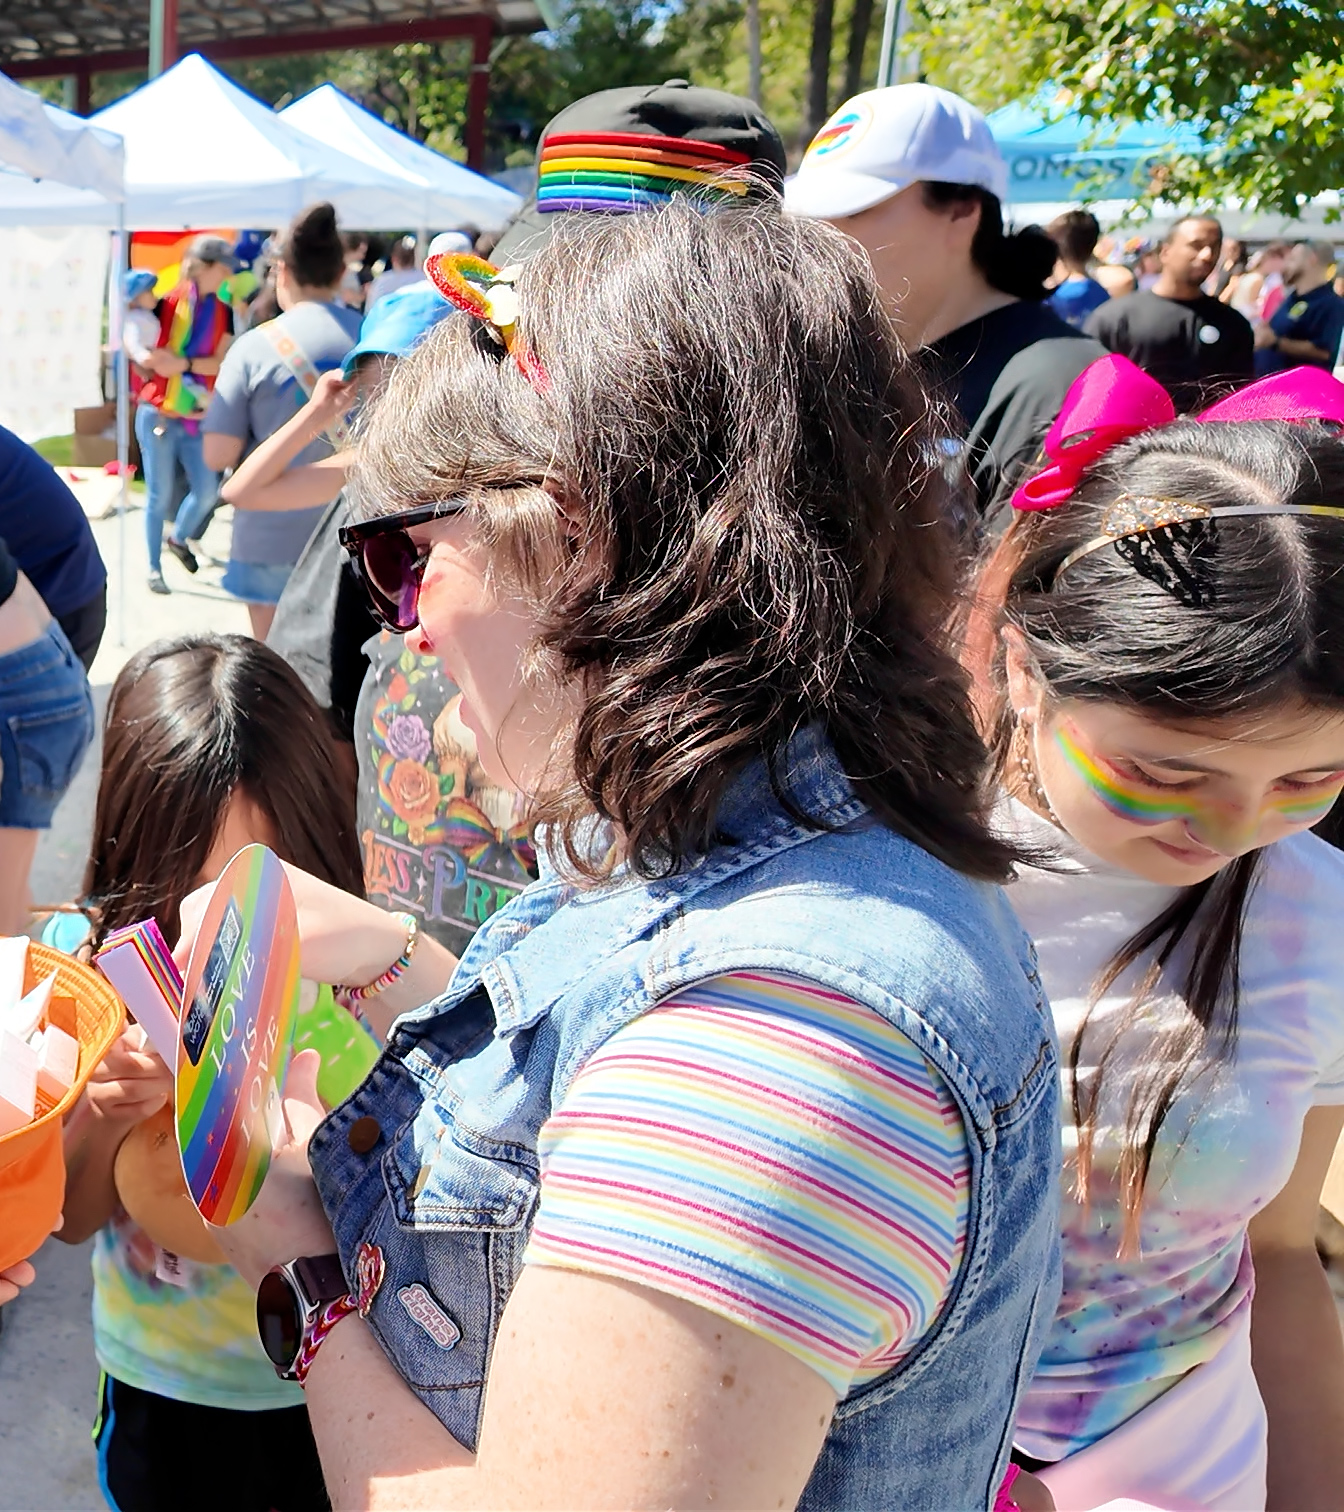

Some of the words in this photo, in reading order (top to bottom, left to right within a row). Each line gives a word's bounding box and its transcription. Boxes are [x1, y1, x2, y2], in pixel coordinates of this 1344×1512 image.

[362, 829, 411, 907] LESS
[210, 941, 255, 1078] LOVE
[241, 1017, 257, 1068] IS
[241, 1014, 279, 1148] LOVE
[400, 1293, 448, 1344] rights
[412, 1288, 455, 1338] trans
